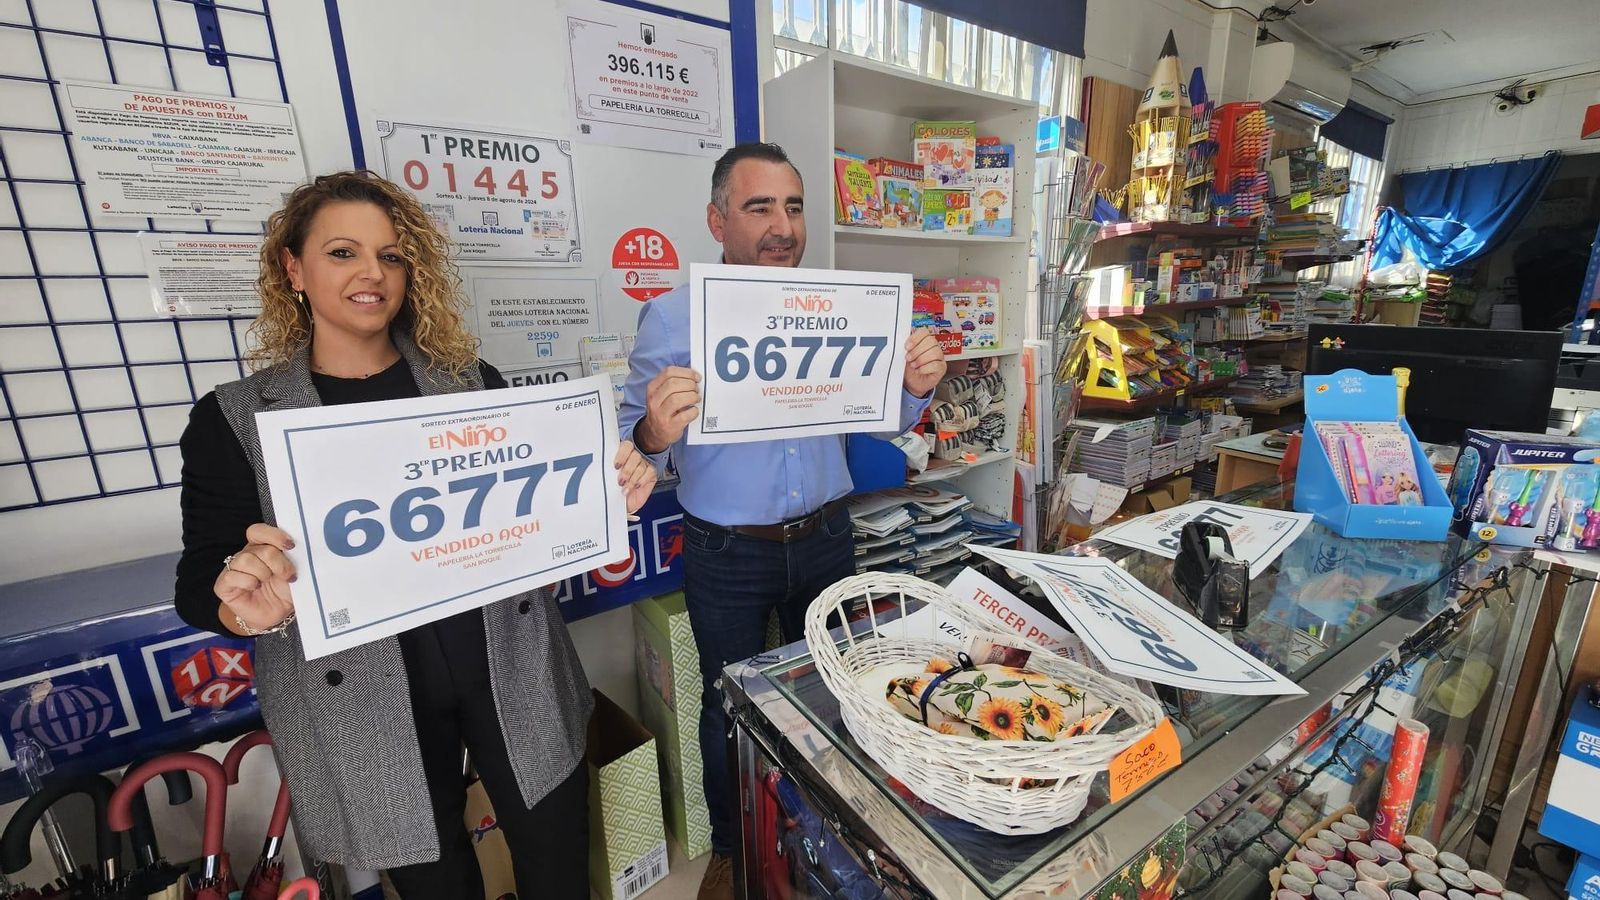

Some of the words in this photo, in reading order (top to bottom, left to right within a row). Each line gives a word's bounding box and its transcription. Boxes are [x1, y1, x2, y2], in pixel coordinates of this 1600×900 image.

[618, 42, 642, 52] Hemos
[644, 45, 678, 59] entregado
[607, 54, 675, 81] 396.115
[679, 68, 689, 84] €
[610, 77, 638, 88] premios
[654, 83, 671, 93] largo
[673, 86, 681, 94] de
[682, 88, 698, 98] 2022
[623, 88, 638, 96] este
[640, 89, 659, 99] punto
[661, 92, 669, 100] de
[671, 94, 688, 103] venta
[134, 94, 163, 104] PAGO
[166, 97, 179, 105] DE
[182, 99, 227, 111] PREMIOS
[601, 99, 643, 112] PAPELERIA
[645, 106, 654, 114] LA
[656, 108, 700, 121] TORRECILLA
[143, 104, 193, 116] APUESTAS
[216, 112, 248, 120] BIZUM
[919, 128, 970, 136] COLORES
[444, 136, 540, 164] PREMIO
[492, 227, 523, 235] Nacional
[624, 234, 664, 260] +18
[794, 294, 833, 314] Niño
[783, 316, 848, 331] PREMIO
[527, 332, 559, 341] 22590
[714, 335, 888, 383] 66777
[511, 371, 569, 388] EMIO
[762, 386, 812, 396] VENDIDO
[574, 398, 596, 409] ENERO
[448, 413, 502, 425] EXTRAORDINARIO
[446, 424, 507, 450] Niño
[1468, 437, 1491, 448] JUPITER
[431, 443, 533, 476] PREMIO
[1512, 449, 1566, 458] JUPITER
[323, 452, 594, 558] 66777
[410, 532, 494, 562] VENDIDO
[438, 554, 474, 568] PAPELERIA
[484, 542, 522, 557] TORRECILLA
[567, 543, 598, 556] NACIONAL
[478, 556, 500, 566] ROQUE
[972, 587, 1026, 633] TERCER
[1125, 743, 1156, 770] Saco
